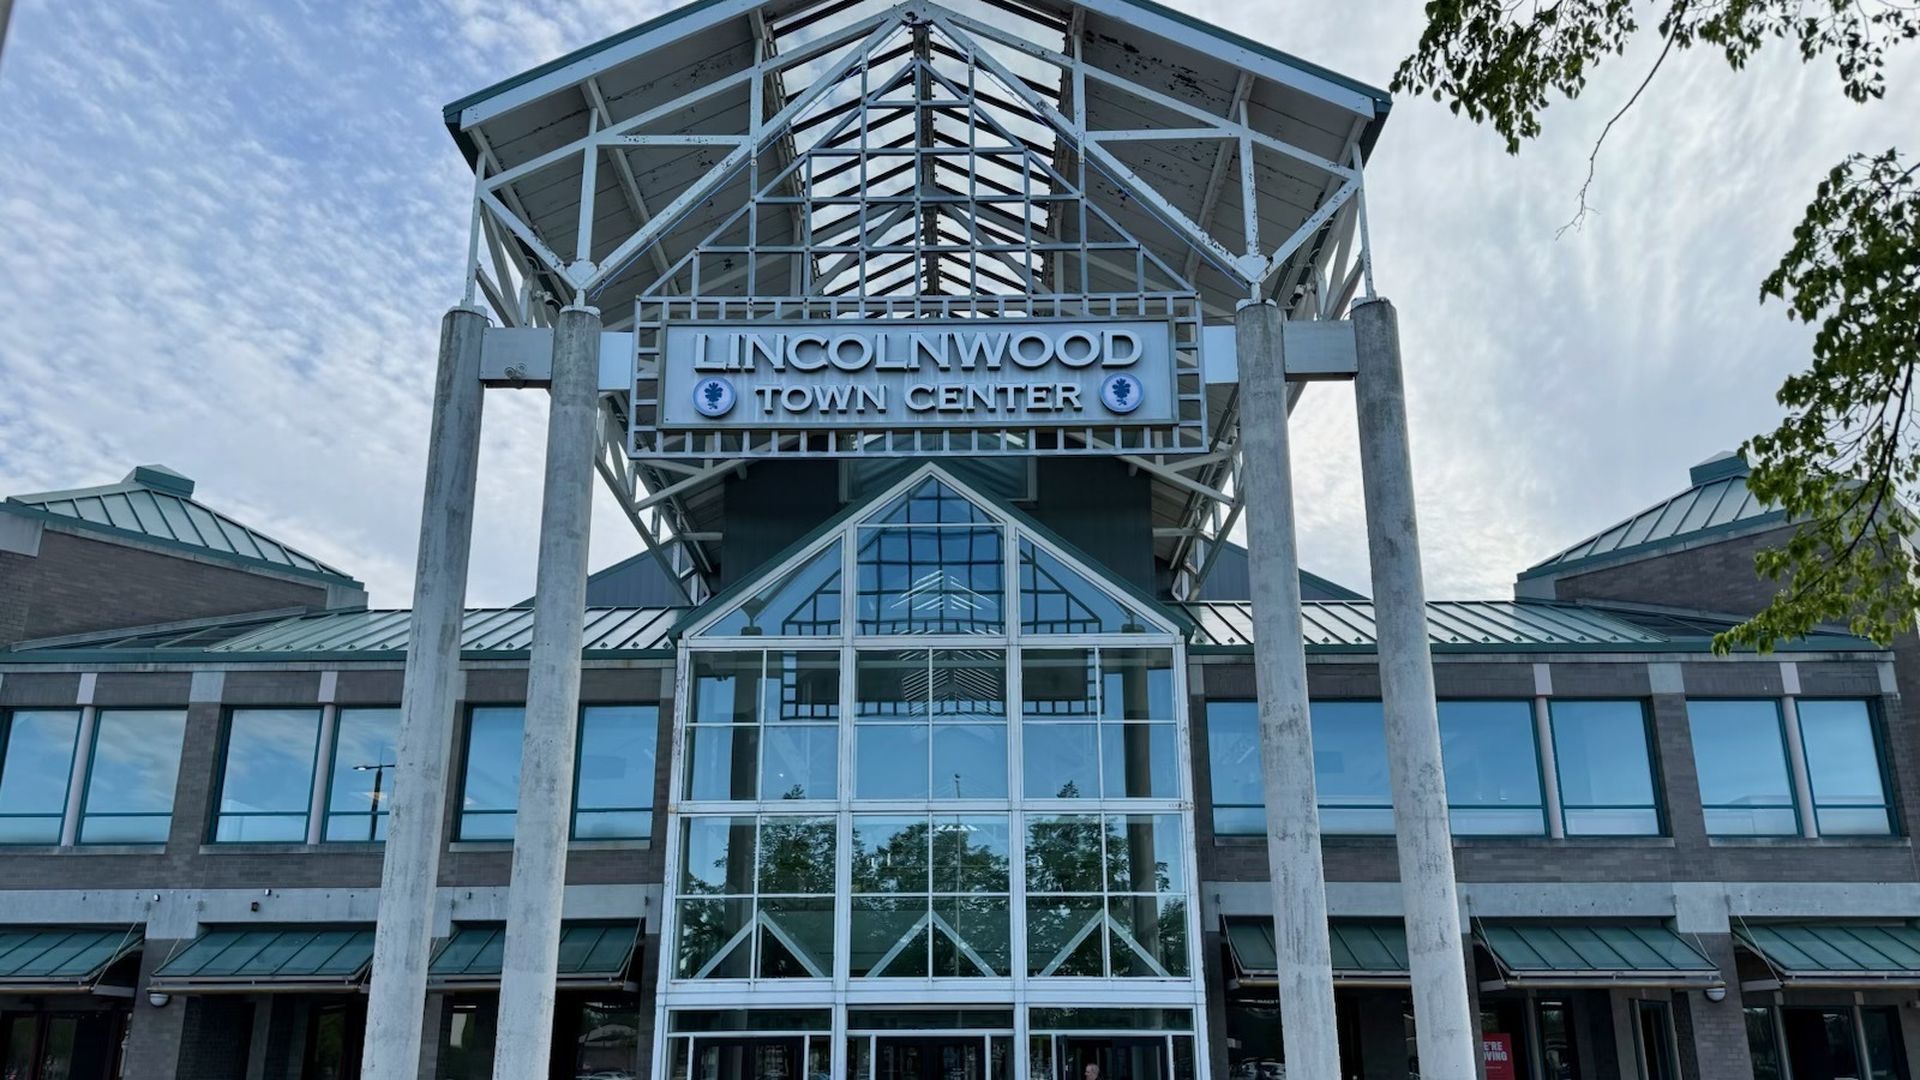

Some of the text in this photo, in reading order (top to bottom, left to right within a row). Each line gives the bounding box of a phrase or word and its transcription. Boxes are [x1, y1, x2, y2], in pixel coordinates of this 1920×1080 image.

[694, 330, 1143, 373] LINCOLNWOOD
[755, 383, 1083, 414] TOWN CENTER
[1483, 1041, 1503, 1051] E'RE
[1483, 1051, 1508, 1061] VING
